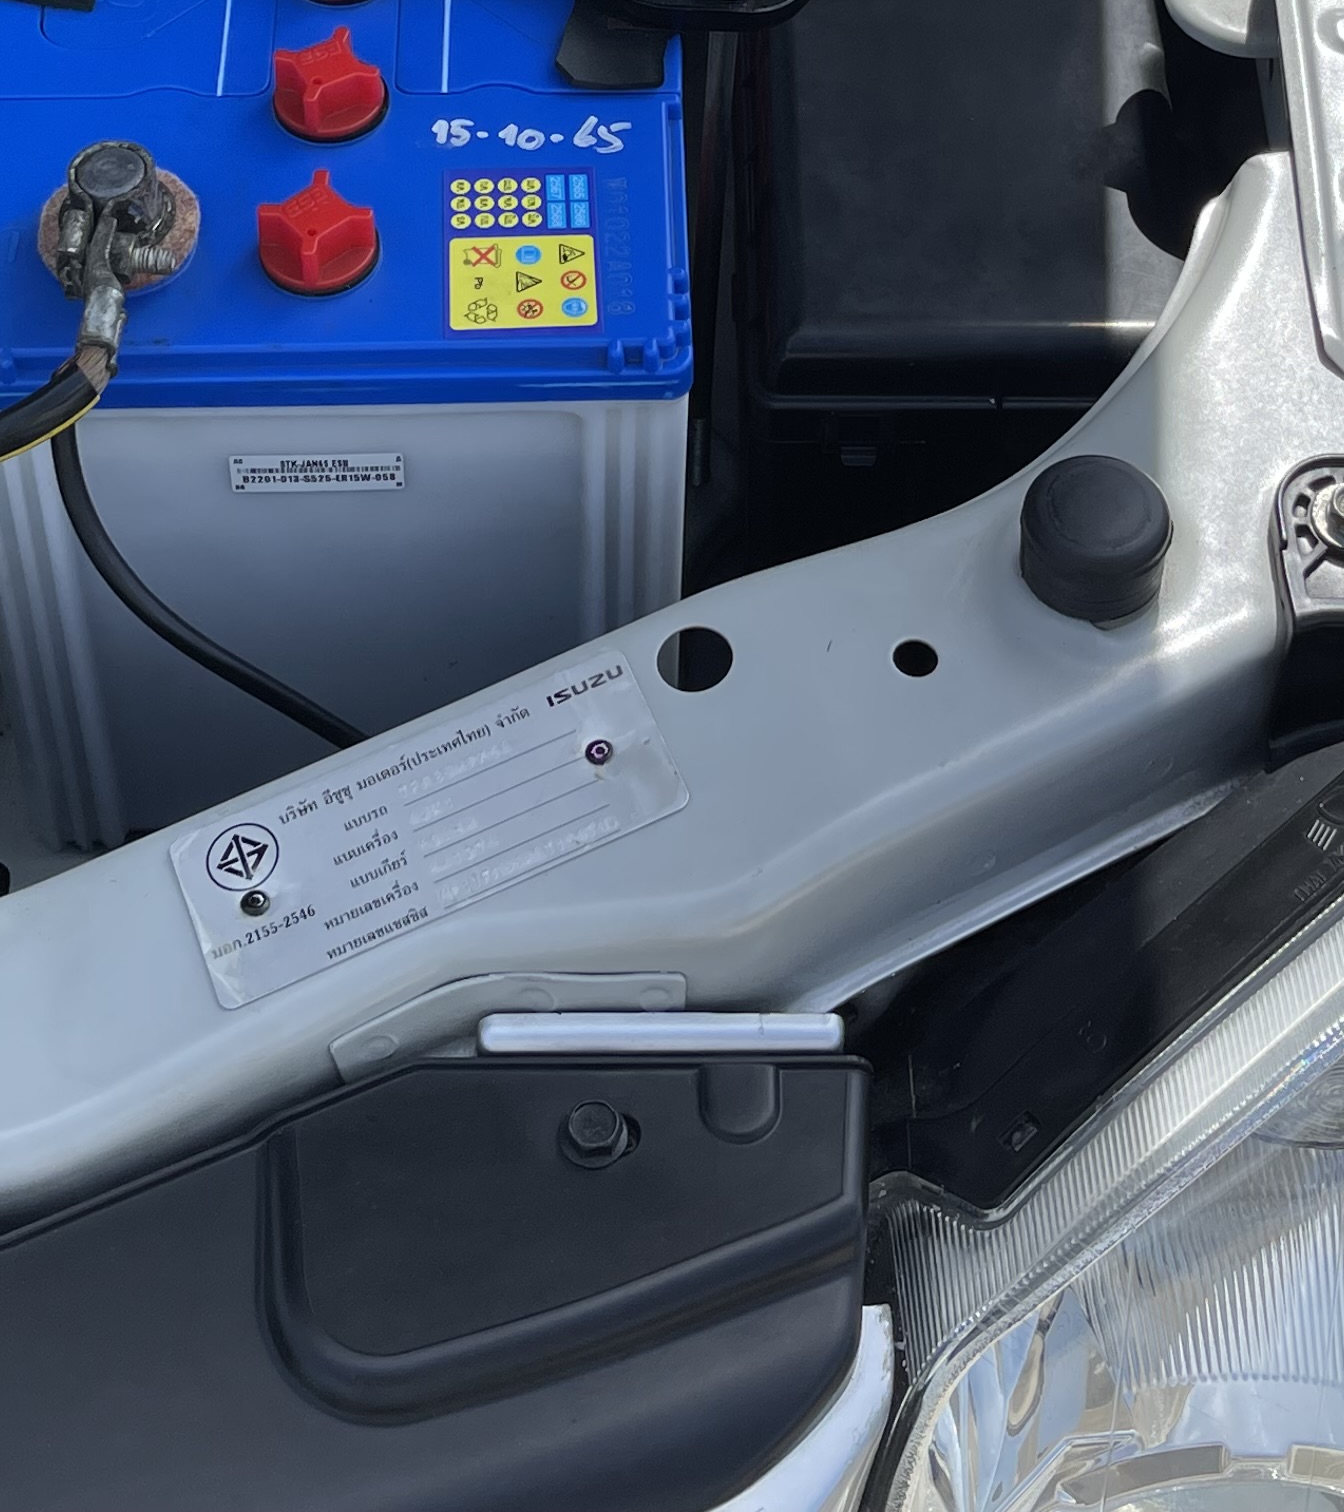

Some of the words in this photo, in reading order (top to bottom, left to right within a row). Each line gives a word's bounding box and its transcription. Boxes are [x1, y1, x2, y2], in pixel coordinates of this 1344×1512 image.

[546, 665, 624, 708] ISUZU
[279, 798, 320, 825] บริษัท
[495, 706, 531, 729] จำกัด
[343, 805, 388, 832] แบบรถ
[333, 829, 399, 866] แบบเครื่อง
[350, 849, 408, 889] แบบเกียร์
[324, 879, 420, 930] หมายเลขเครื่อง
[211, 904, 316, 960] มอก.2155-2546
